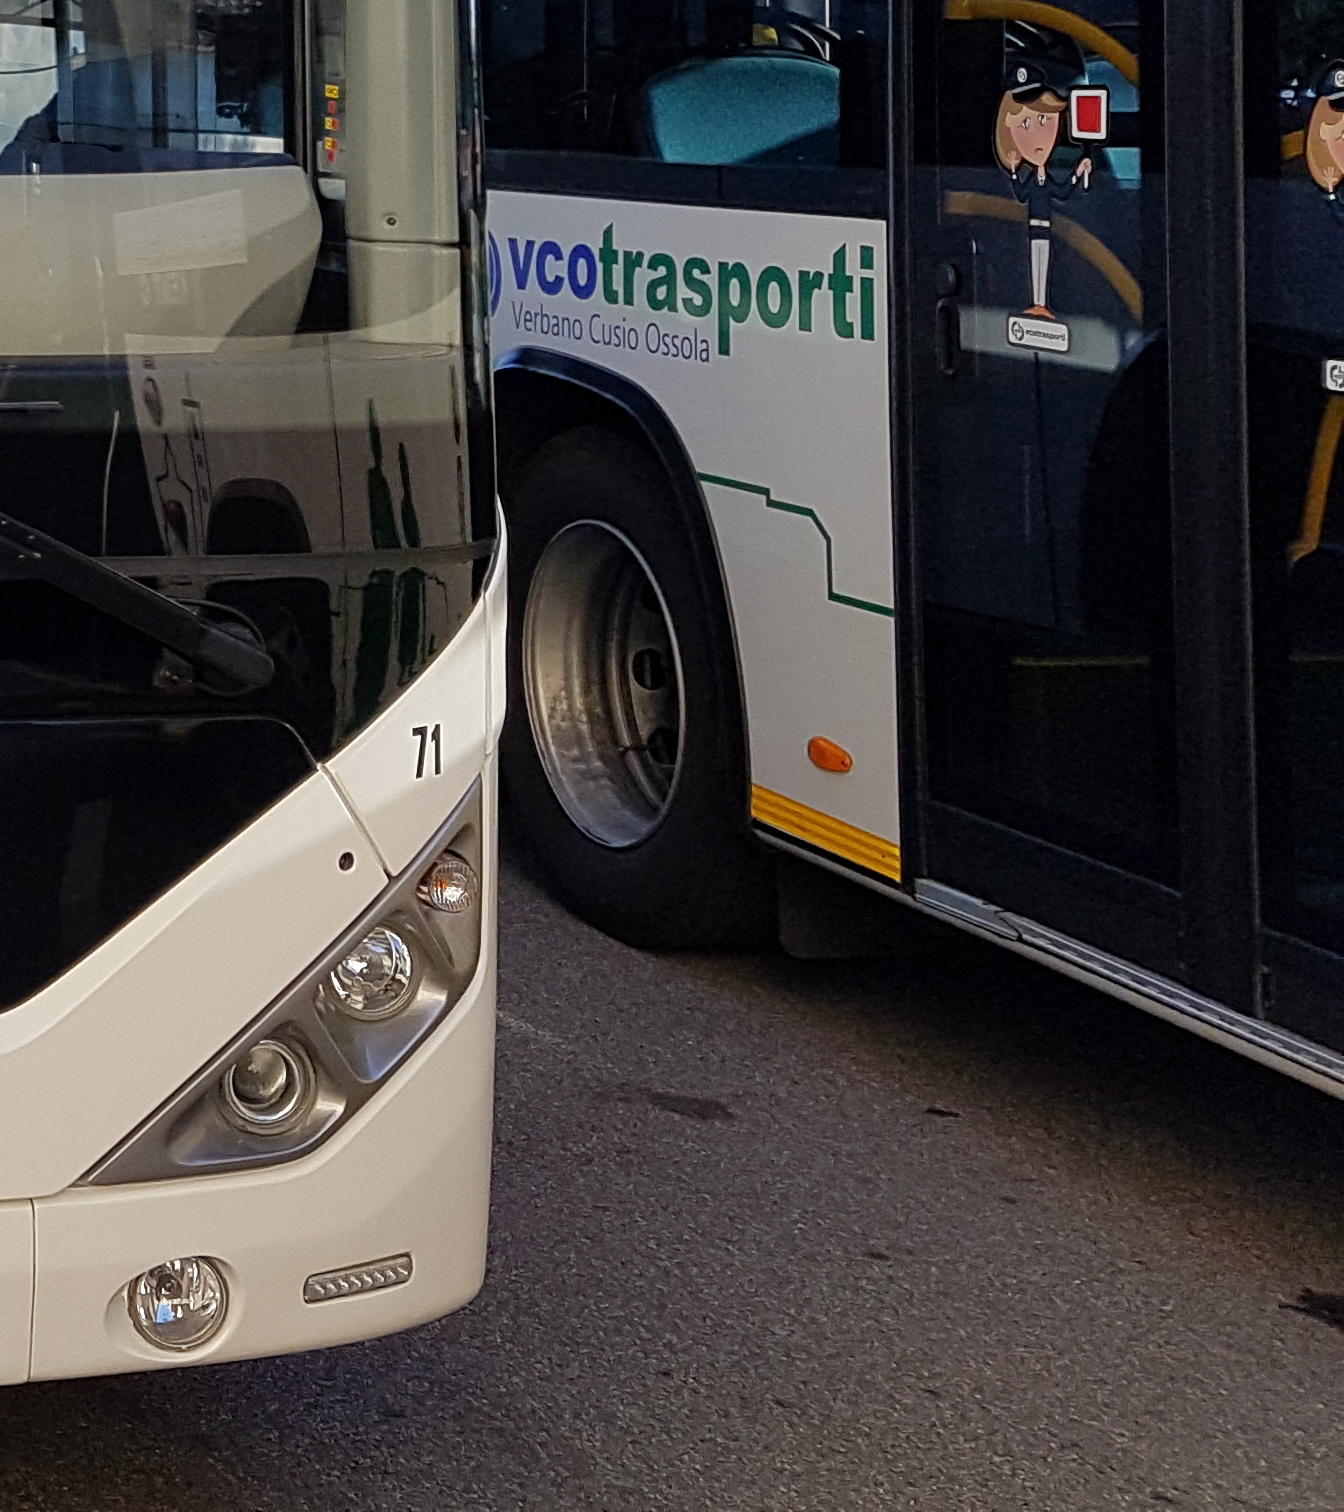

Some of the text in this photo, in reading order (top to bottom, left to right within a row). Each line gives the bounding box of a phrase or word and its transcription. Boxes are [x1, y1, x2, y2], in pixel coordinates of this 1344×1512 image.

[507, 221, 876, 356] vcotrasporti
[511, 300, 711, 363] Verbano Cusio Ossola
[411, 723, 442, 780] 71
